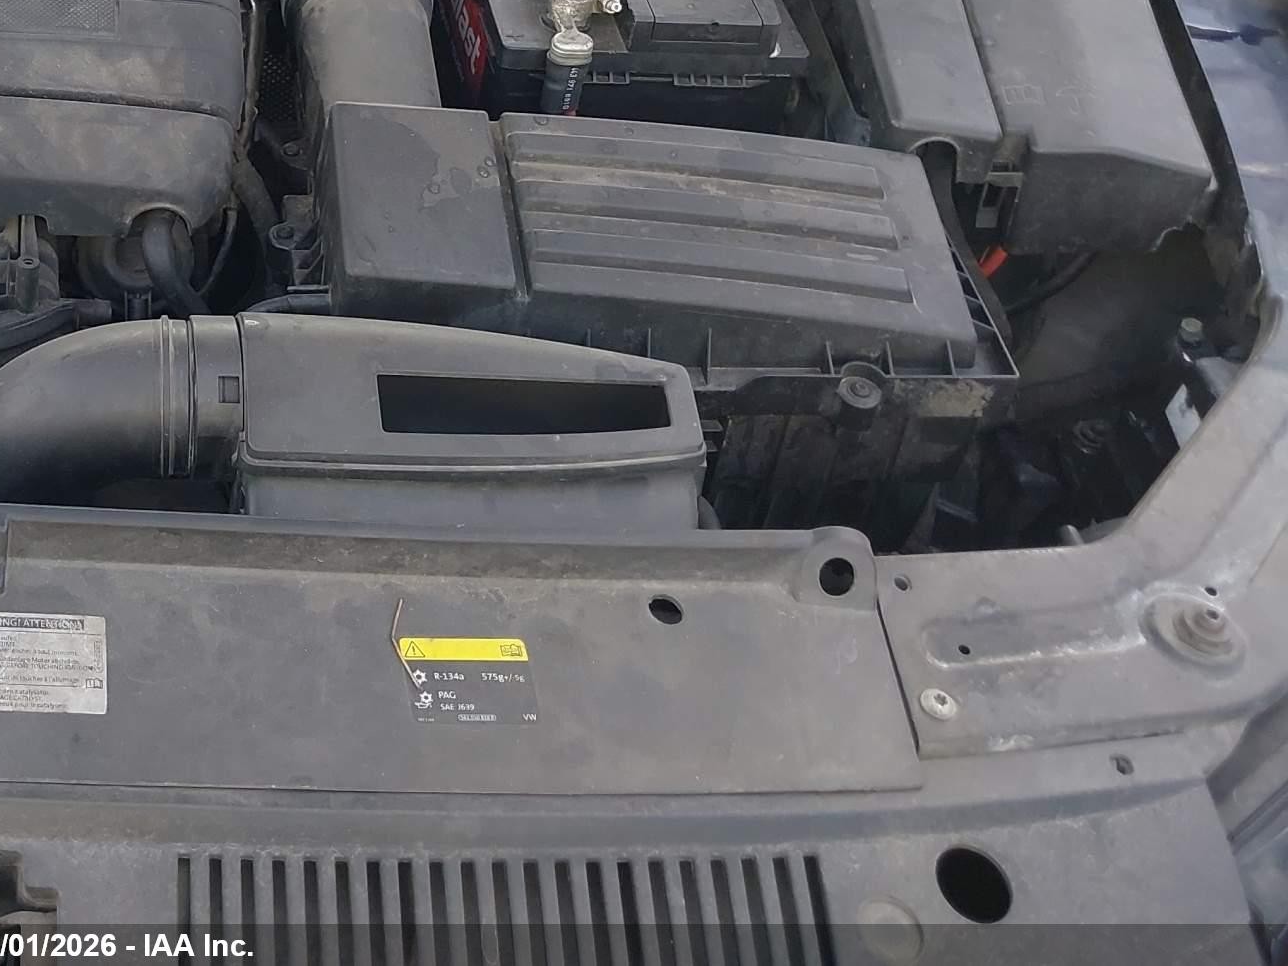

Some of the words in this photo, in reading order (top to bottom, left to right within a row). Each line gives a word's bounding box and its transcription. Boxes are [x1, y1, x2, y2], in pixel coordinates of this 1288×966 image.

[434, 672, 465, 681] R-134a
[438, 691, 457, 699] PAG
[440, 703, 455, 711] SAE
[522, 713, 537, 722] VW
